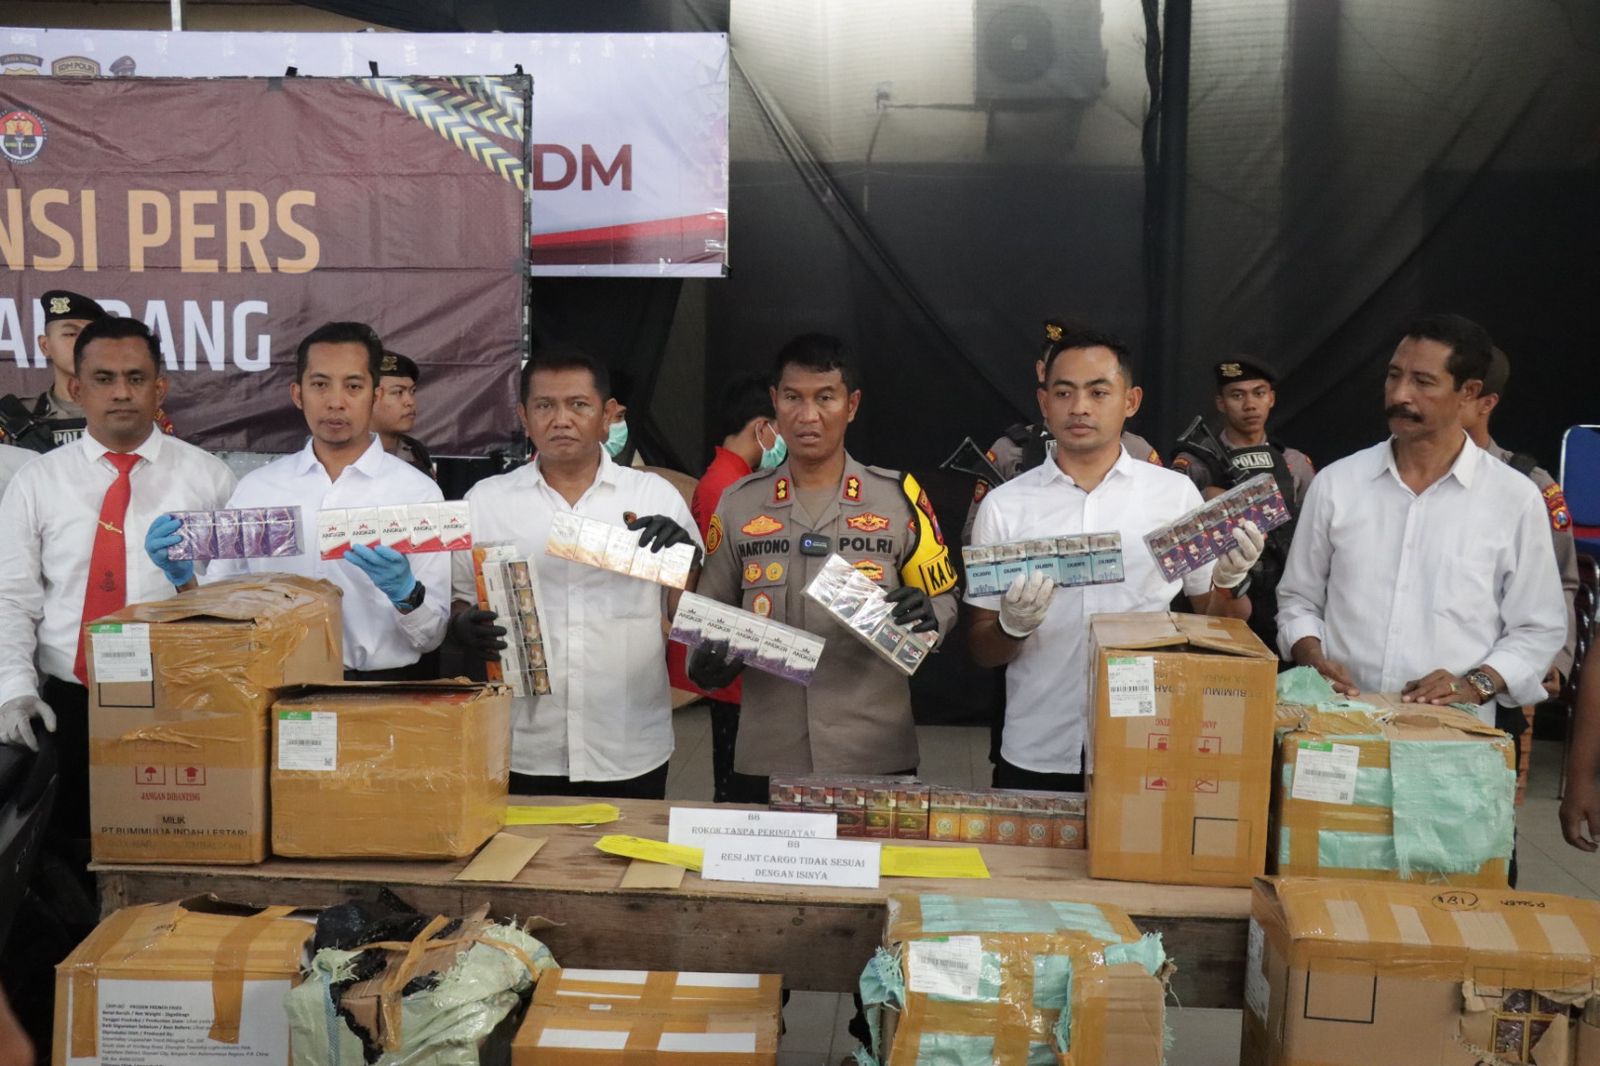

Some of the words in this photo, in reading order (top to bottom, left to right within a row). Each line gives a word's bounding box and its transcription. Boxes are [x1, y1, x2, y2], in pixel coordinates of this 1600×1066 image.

[128, 190, 321, 274] PERS
[1232, 454, 1271, 469] POLISI
[839, 537, 893, 554] POLRI
[927, 561, 948, 591] KA
[140, 791, 166, 801] JANGAN
[162, 816, 185, 825] MILIK
[747, 813, 760, 821] BB
[691, 826, 721, 834] ROKOK
[724, 827, 755, 835] TANPA
[757, 828, 816, 837] PERINGATAN
[787, 840, 800, 848] BB
[721, 852, 742, 861] RESI
[744, 854, 762, 863] JNT
[763, 854, 797, 864] CARGO
[800, 856, 828, 866] TIDAK
[829, 858, 865, 868] SESUAI
[755, 868, 794, 878] DENGAN
[796, 870, 828, 880] ISINYA
